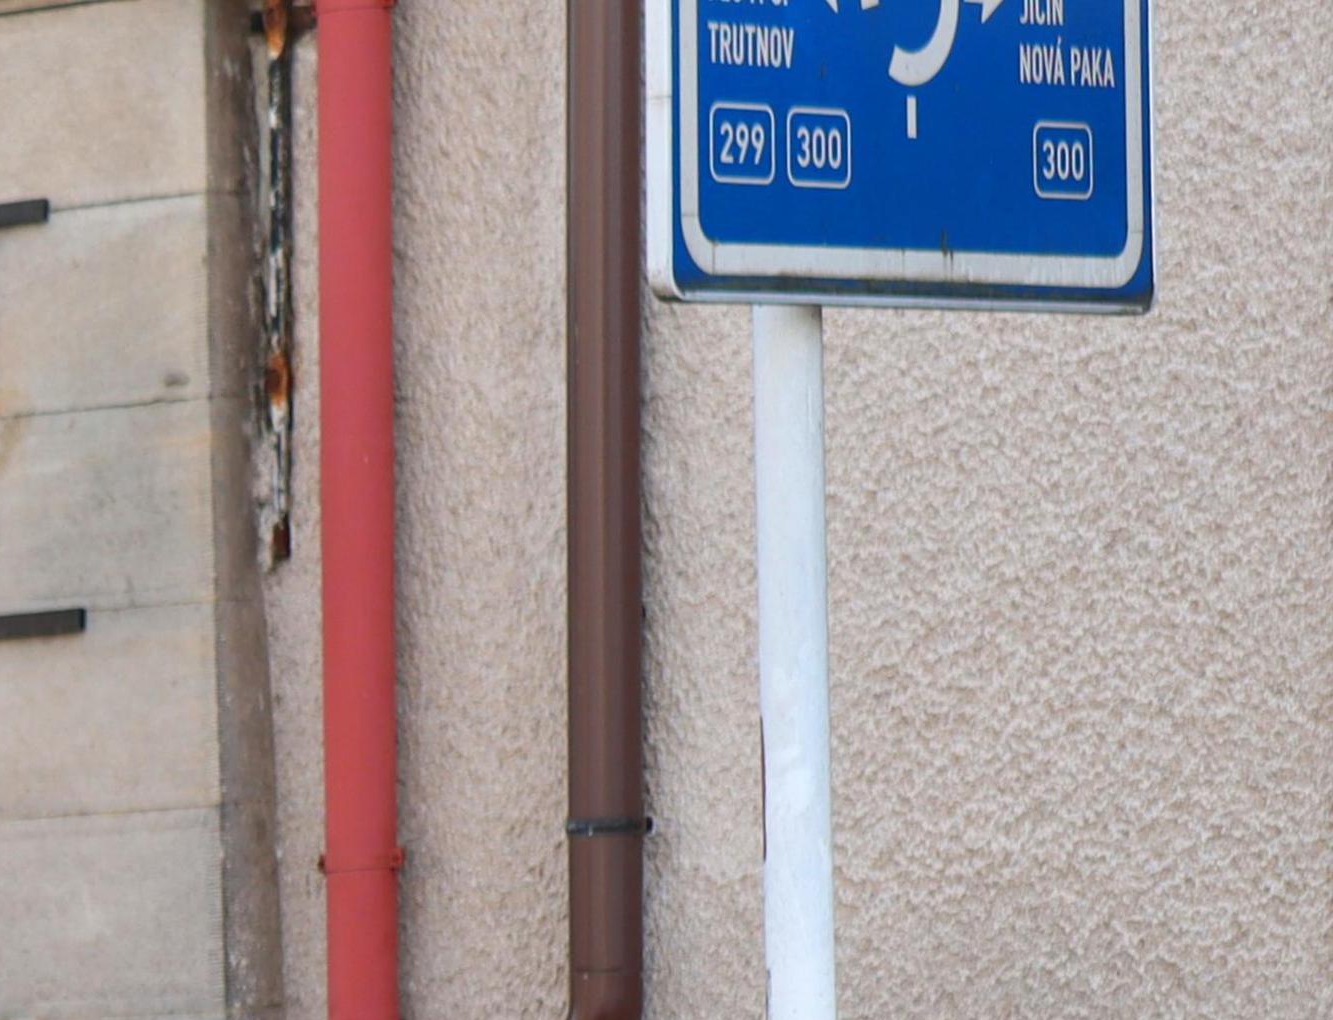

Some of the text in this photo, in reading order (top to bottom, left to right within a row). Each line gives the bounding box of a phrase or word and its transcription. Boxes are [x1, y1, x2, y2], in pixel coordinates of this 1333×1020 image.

[707, 21, 794, 69] TRUTNOV
[1019, 35, 1116, 88] NOVÁ PAKA
[719, 121, 766, 165] 299
[797, 127, 843, 169] 300
[1042, 141, 1085, 181] 300
